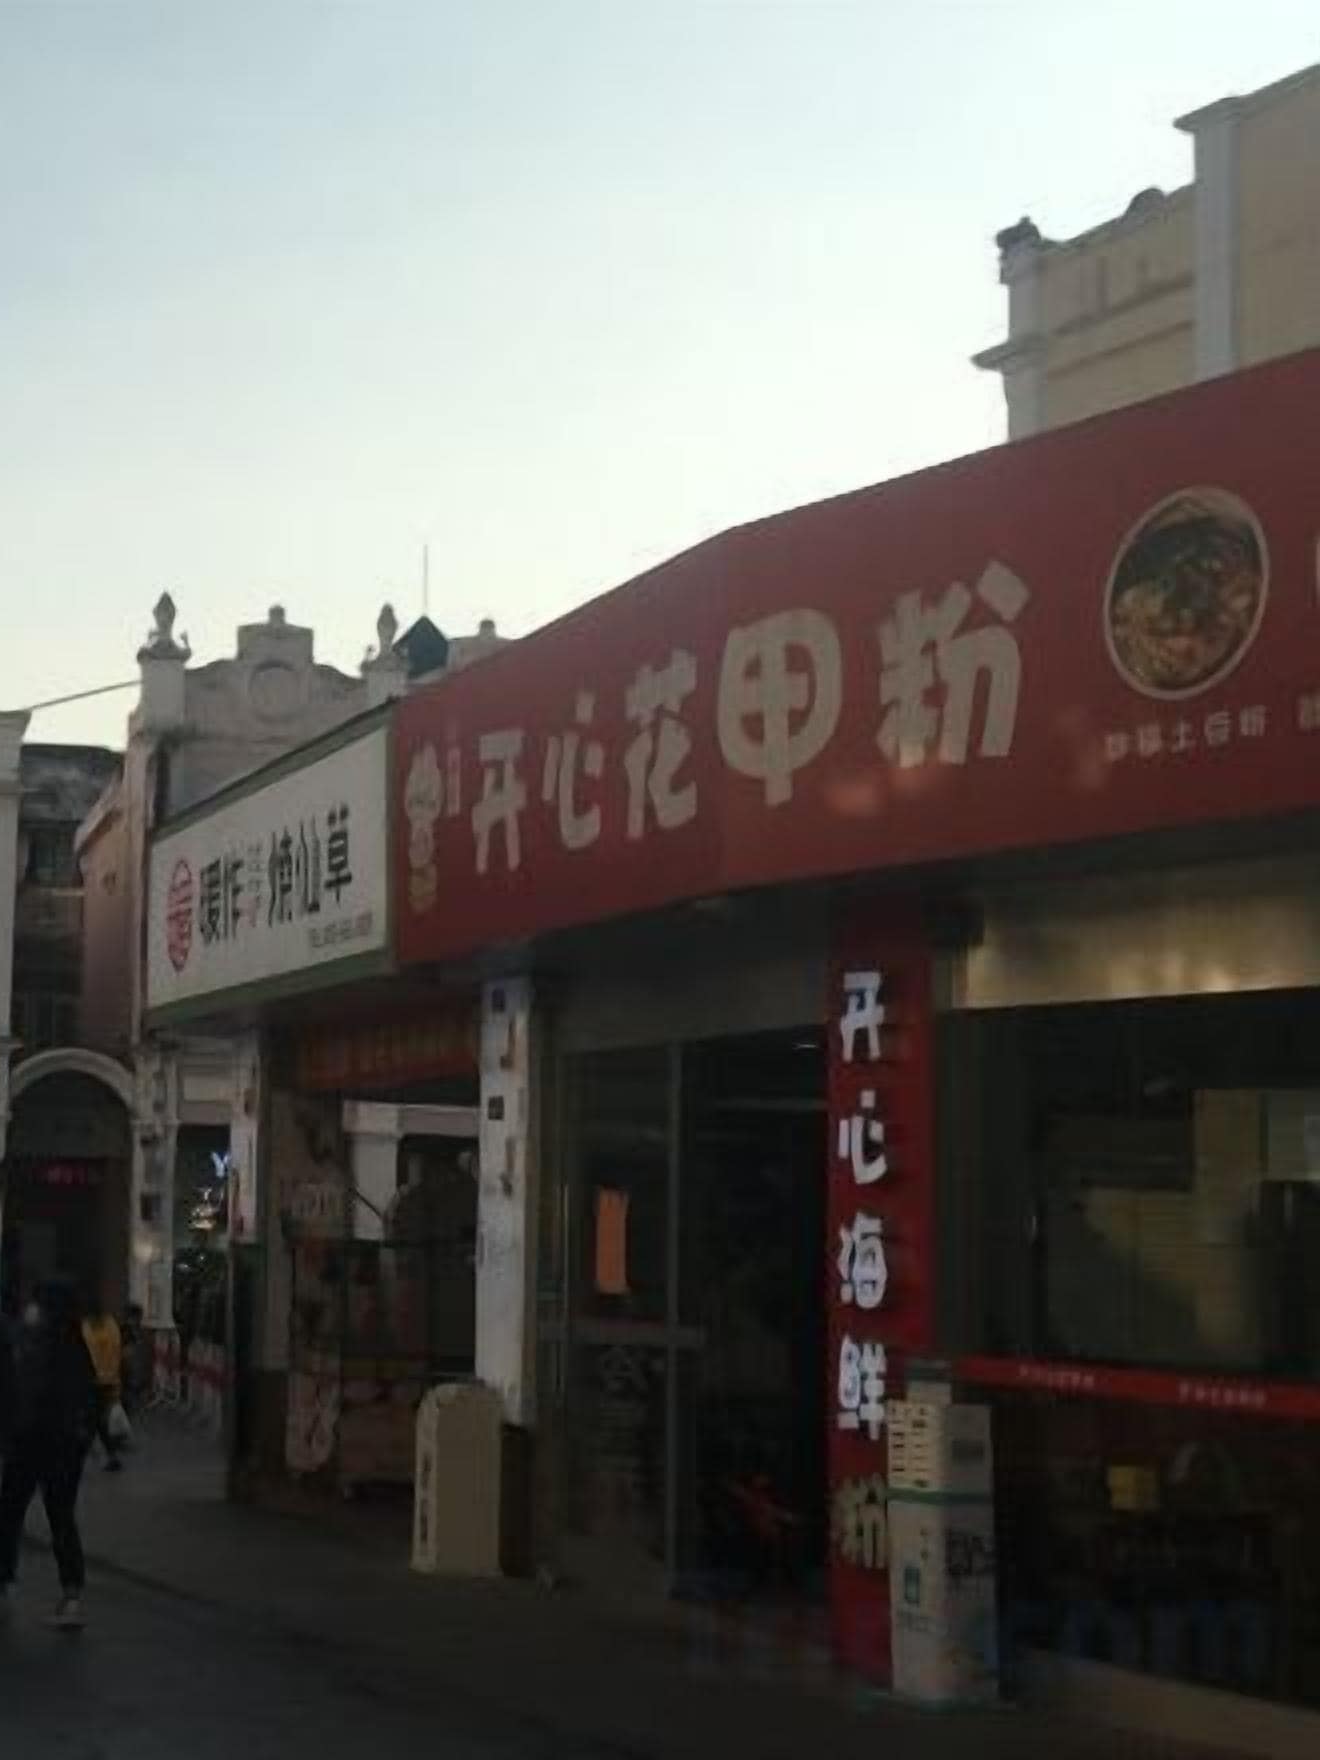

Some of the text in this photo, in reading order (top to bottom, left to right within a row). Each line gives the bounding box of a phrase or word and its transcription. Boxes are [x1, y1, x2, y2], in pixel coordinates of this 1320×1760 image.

[471, 561, 1030, 874] 开心花甲粉
